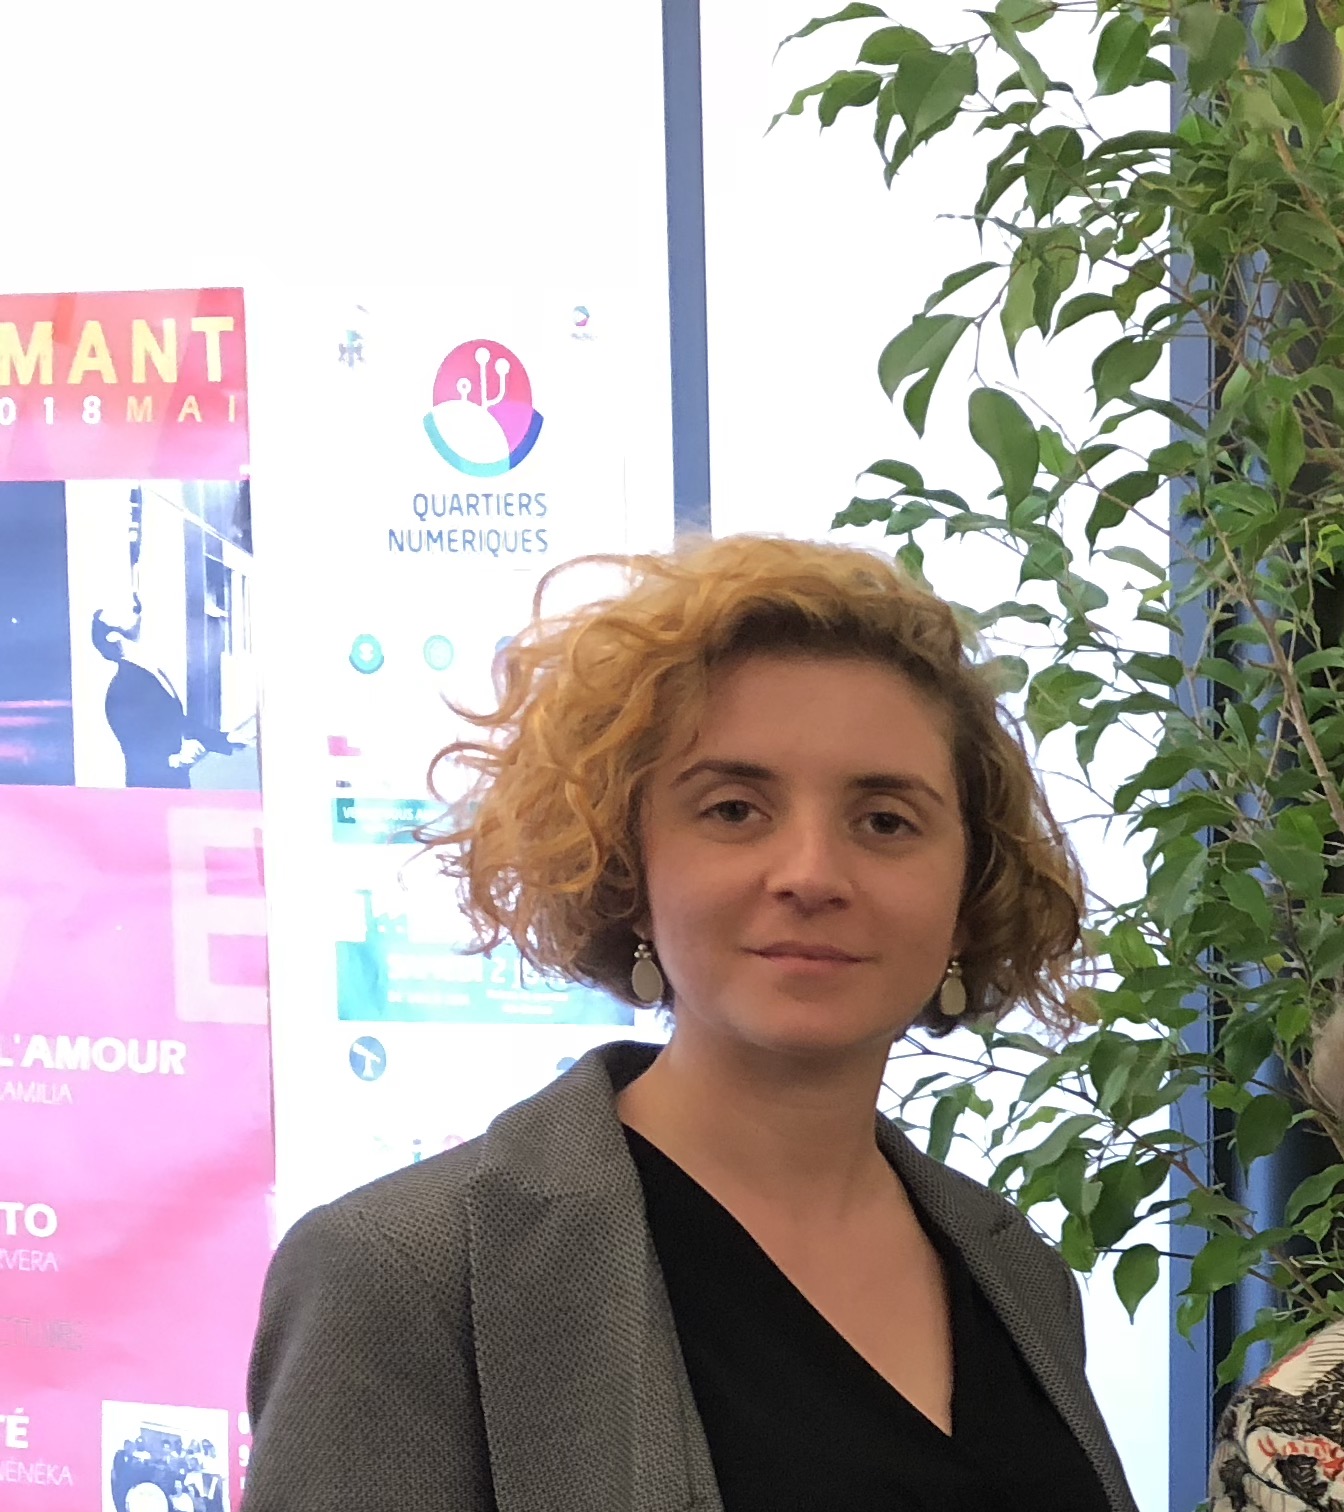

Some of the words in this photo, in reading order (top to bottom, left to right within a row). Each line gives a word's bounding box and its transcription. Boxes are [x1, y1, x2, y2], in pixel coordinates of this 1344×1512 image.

[0, 316, 234, 386] MANT
[126, 395, 236, 423] MAI
[412, 493, 548, 521] QUARTIERS
